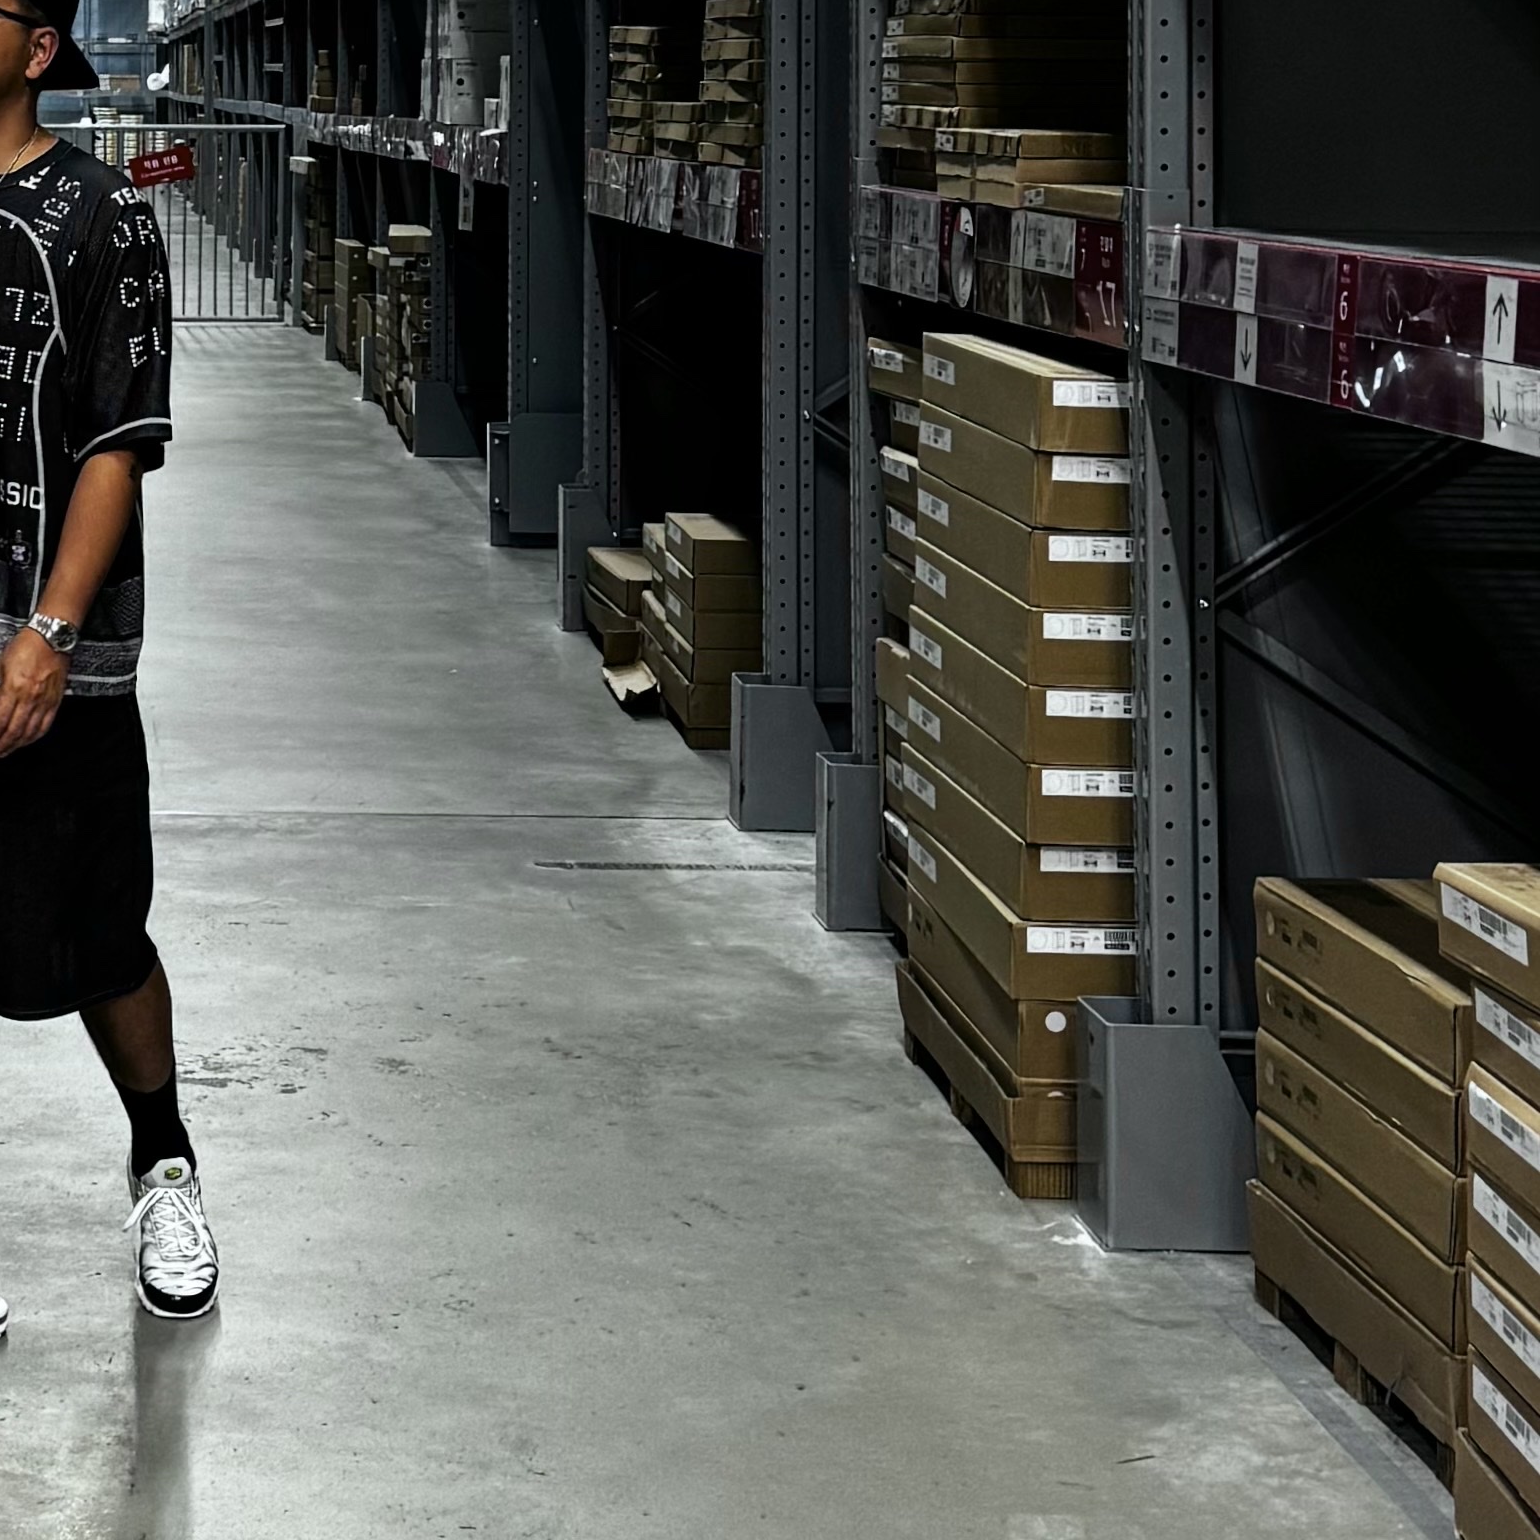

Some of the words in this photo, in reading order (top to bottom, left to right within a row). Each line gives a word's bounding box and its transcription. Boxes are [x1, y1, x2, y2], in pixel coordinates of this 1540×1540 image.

[1096, 280, 1116, 328] 17
[1339, 291, 1348, 321] 6
[1340, 369, 1349, 400] 6
